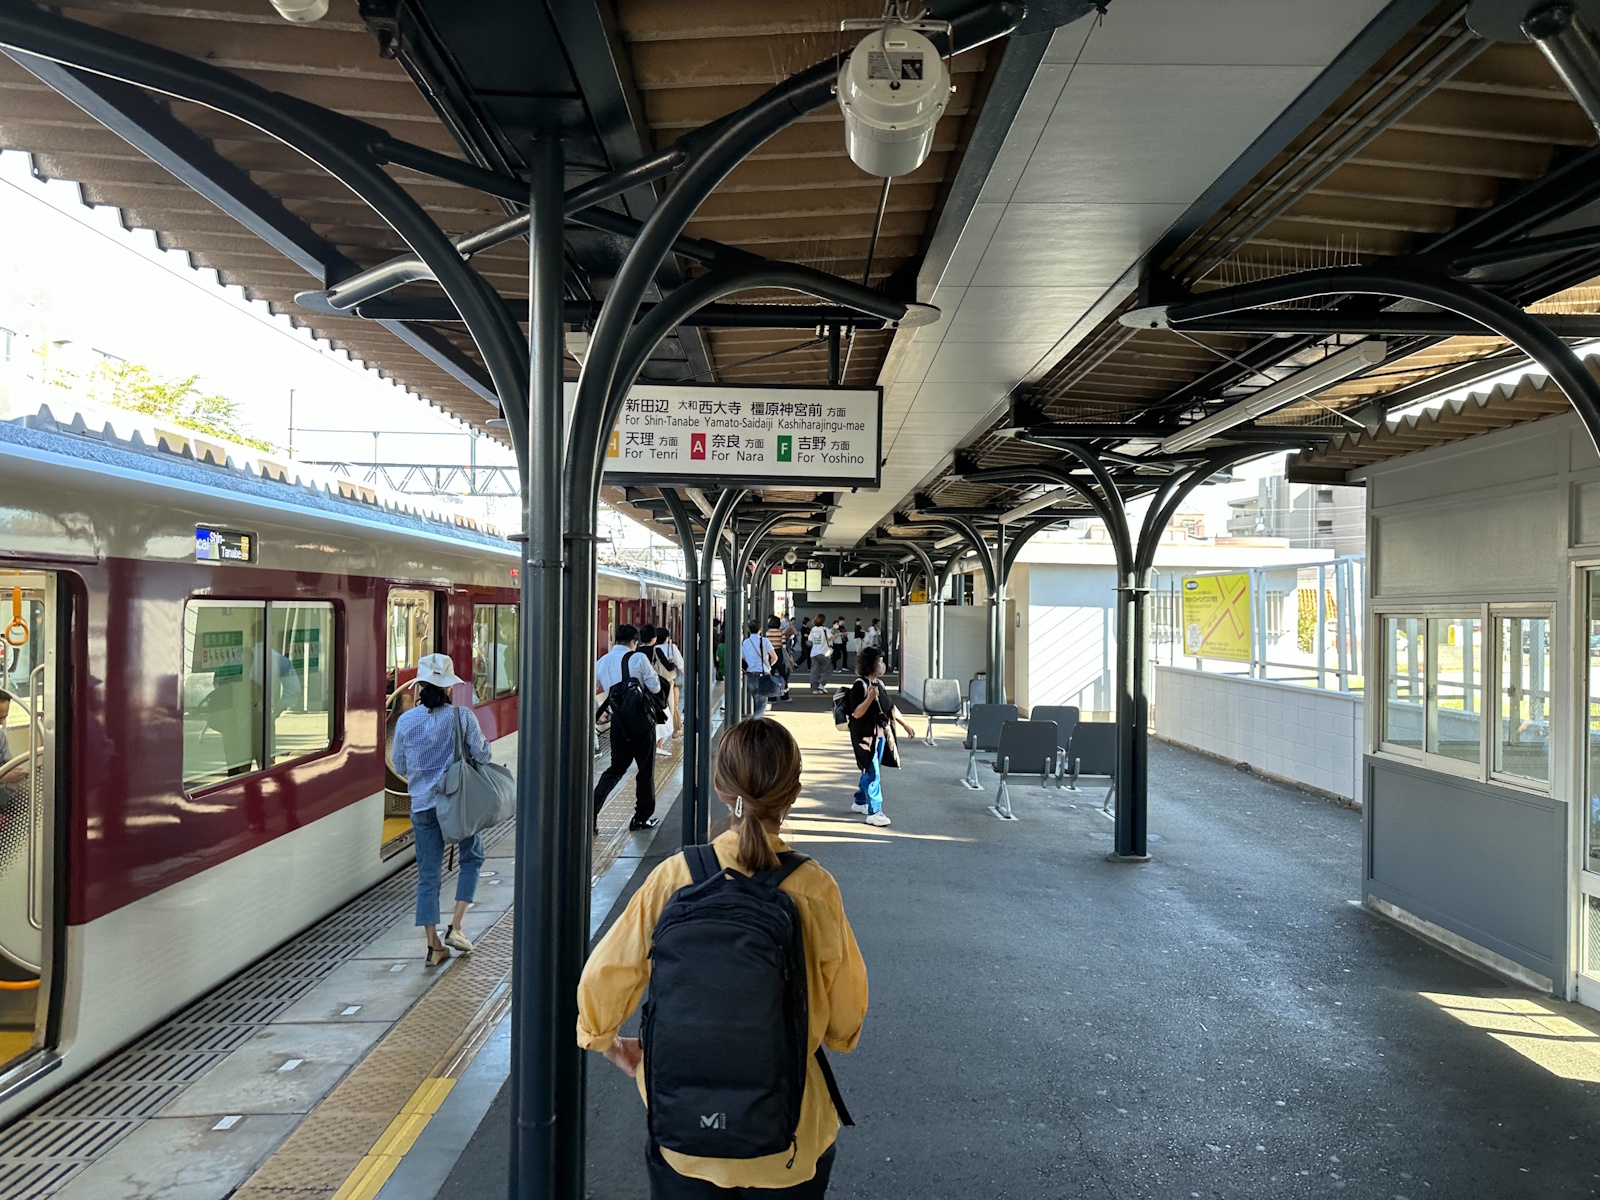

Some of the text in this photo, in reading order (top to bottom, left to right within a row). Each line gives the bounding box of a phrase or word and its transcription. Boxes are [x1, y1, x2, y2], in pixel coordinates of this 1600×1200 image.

[625, 398, 847, 418] 新田辺 大和西大寺 橿原神宮前 方面
[625, 414, 865, 433] For Shin-Tanabe Yamato-Saidaiji Kashiharajingu-mae
[625, 431, 679, 447] 天理 方面
[712, 434, 765, 449] 奈良 方面
[798, 436, 850, 451] 吉野 方面
[692, 440, 704, 453] A
[781, 442, 788, 455] F
[625, 448, 678, 460] For Tenri
[711, 450, 764, 462] For Nara
[797, 452, 865, 464] For Yoshino
